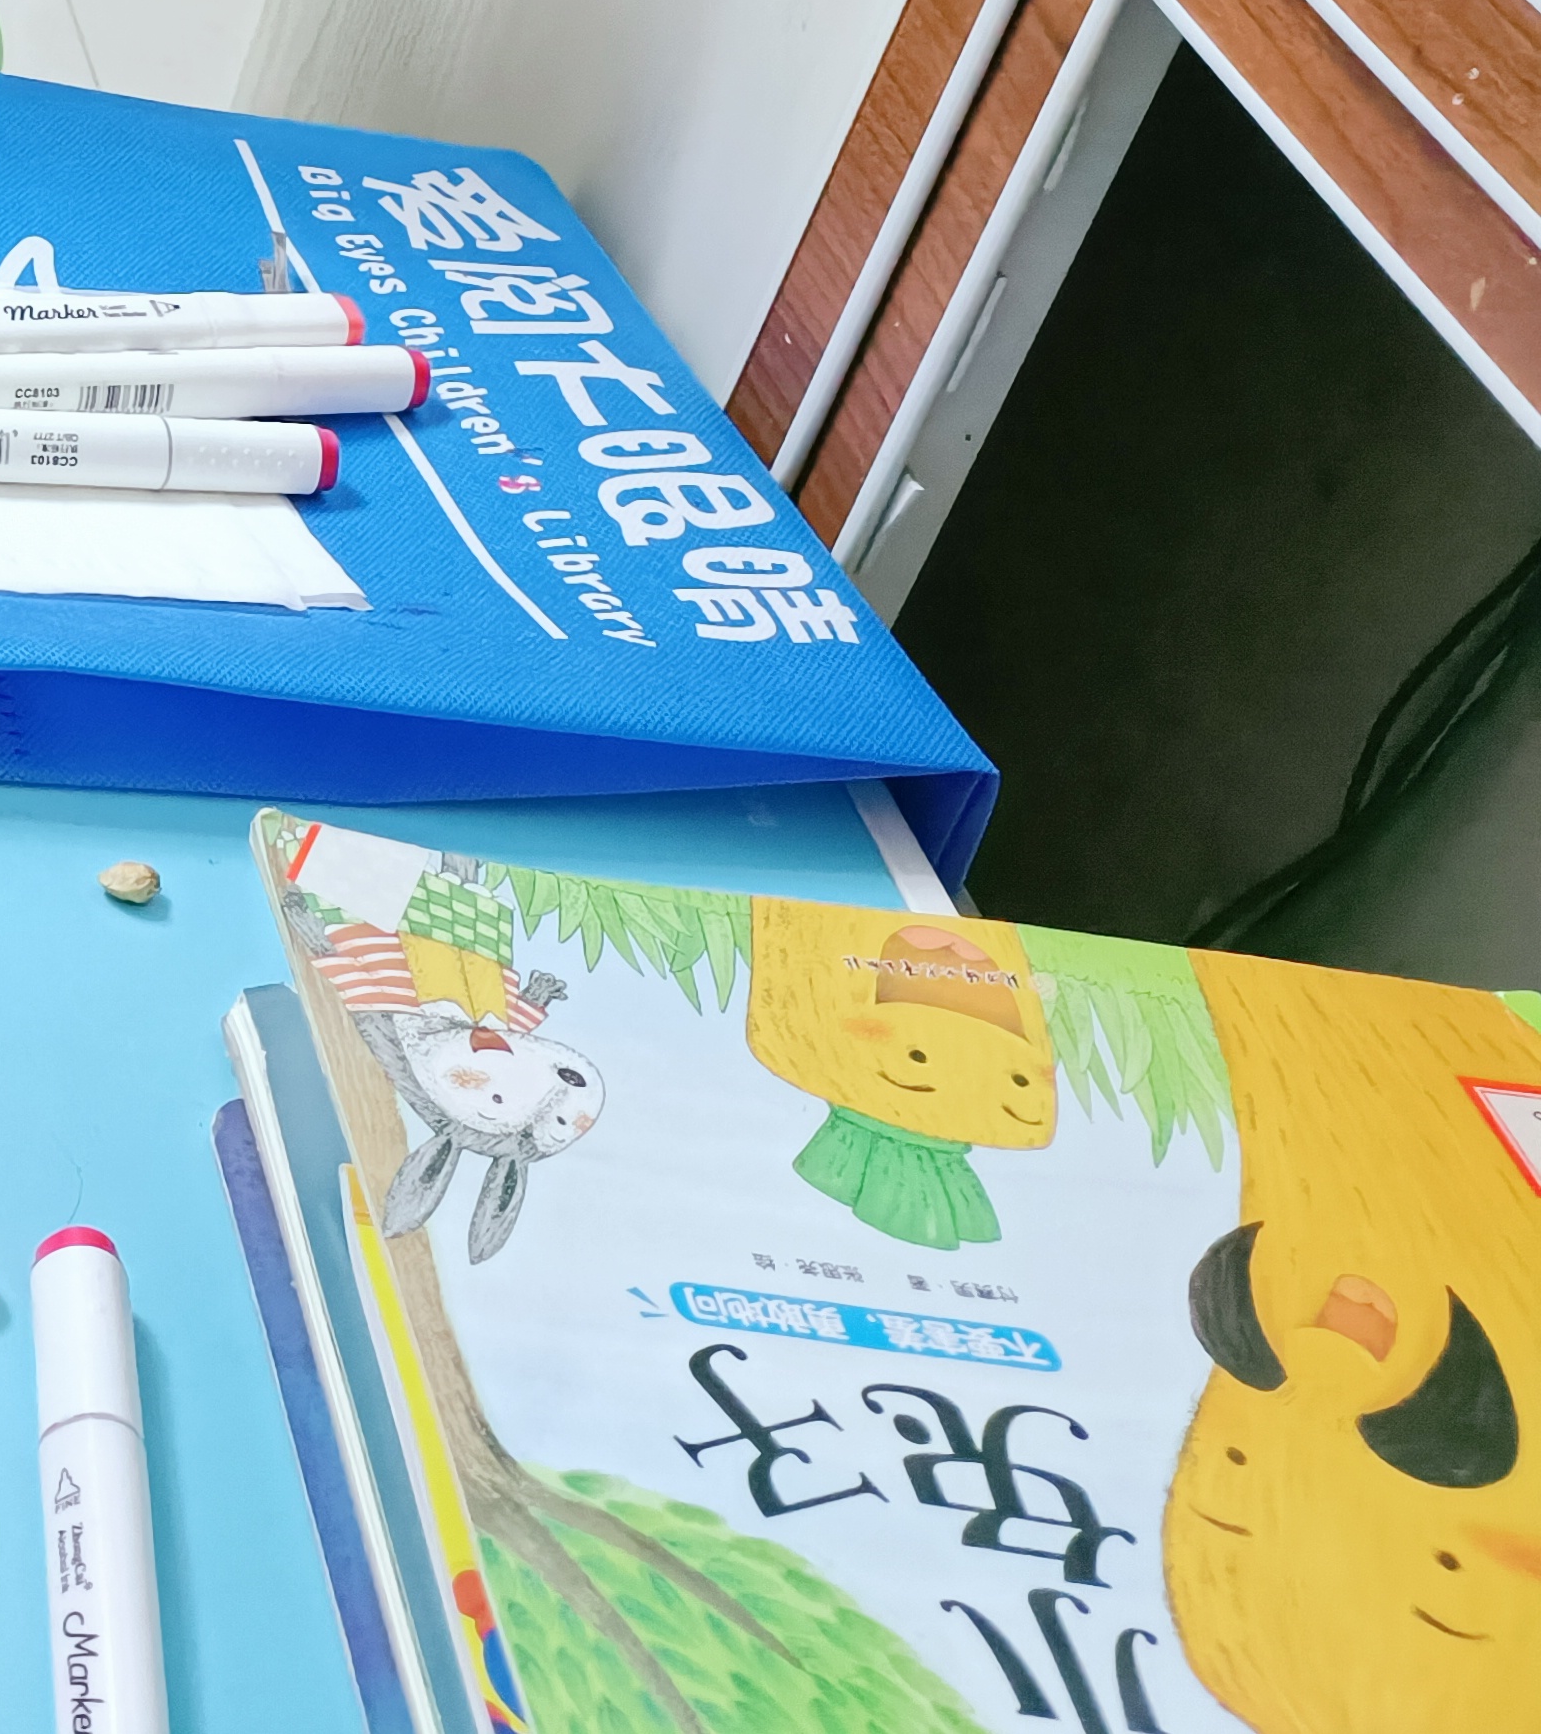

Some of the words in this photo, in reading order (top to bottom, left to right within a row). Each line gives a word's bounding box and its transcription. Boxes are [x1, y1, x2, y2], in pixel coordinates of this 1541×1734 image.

[3, 303, 99, 321] Marker
[14, 387, 60, 399] CC8103
[298, 165, 355, 223] Big
[335, 233, 407, 295] Eyes
[389, 308, 545, 494] Children's
[523, 510, 658, 648] Library
[362, 166, 861, 647] 爱阅大眼睛
[30, 454, 79, 467] CC8103
[673, 1343, 1169, 1734] 小兔子
